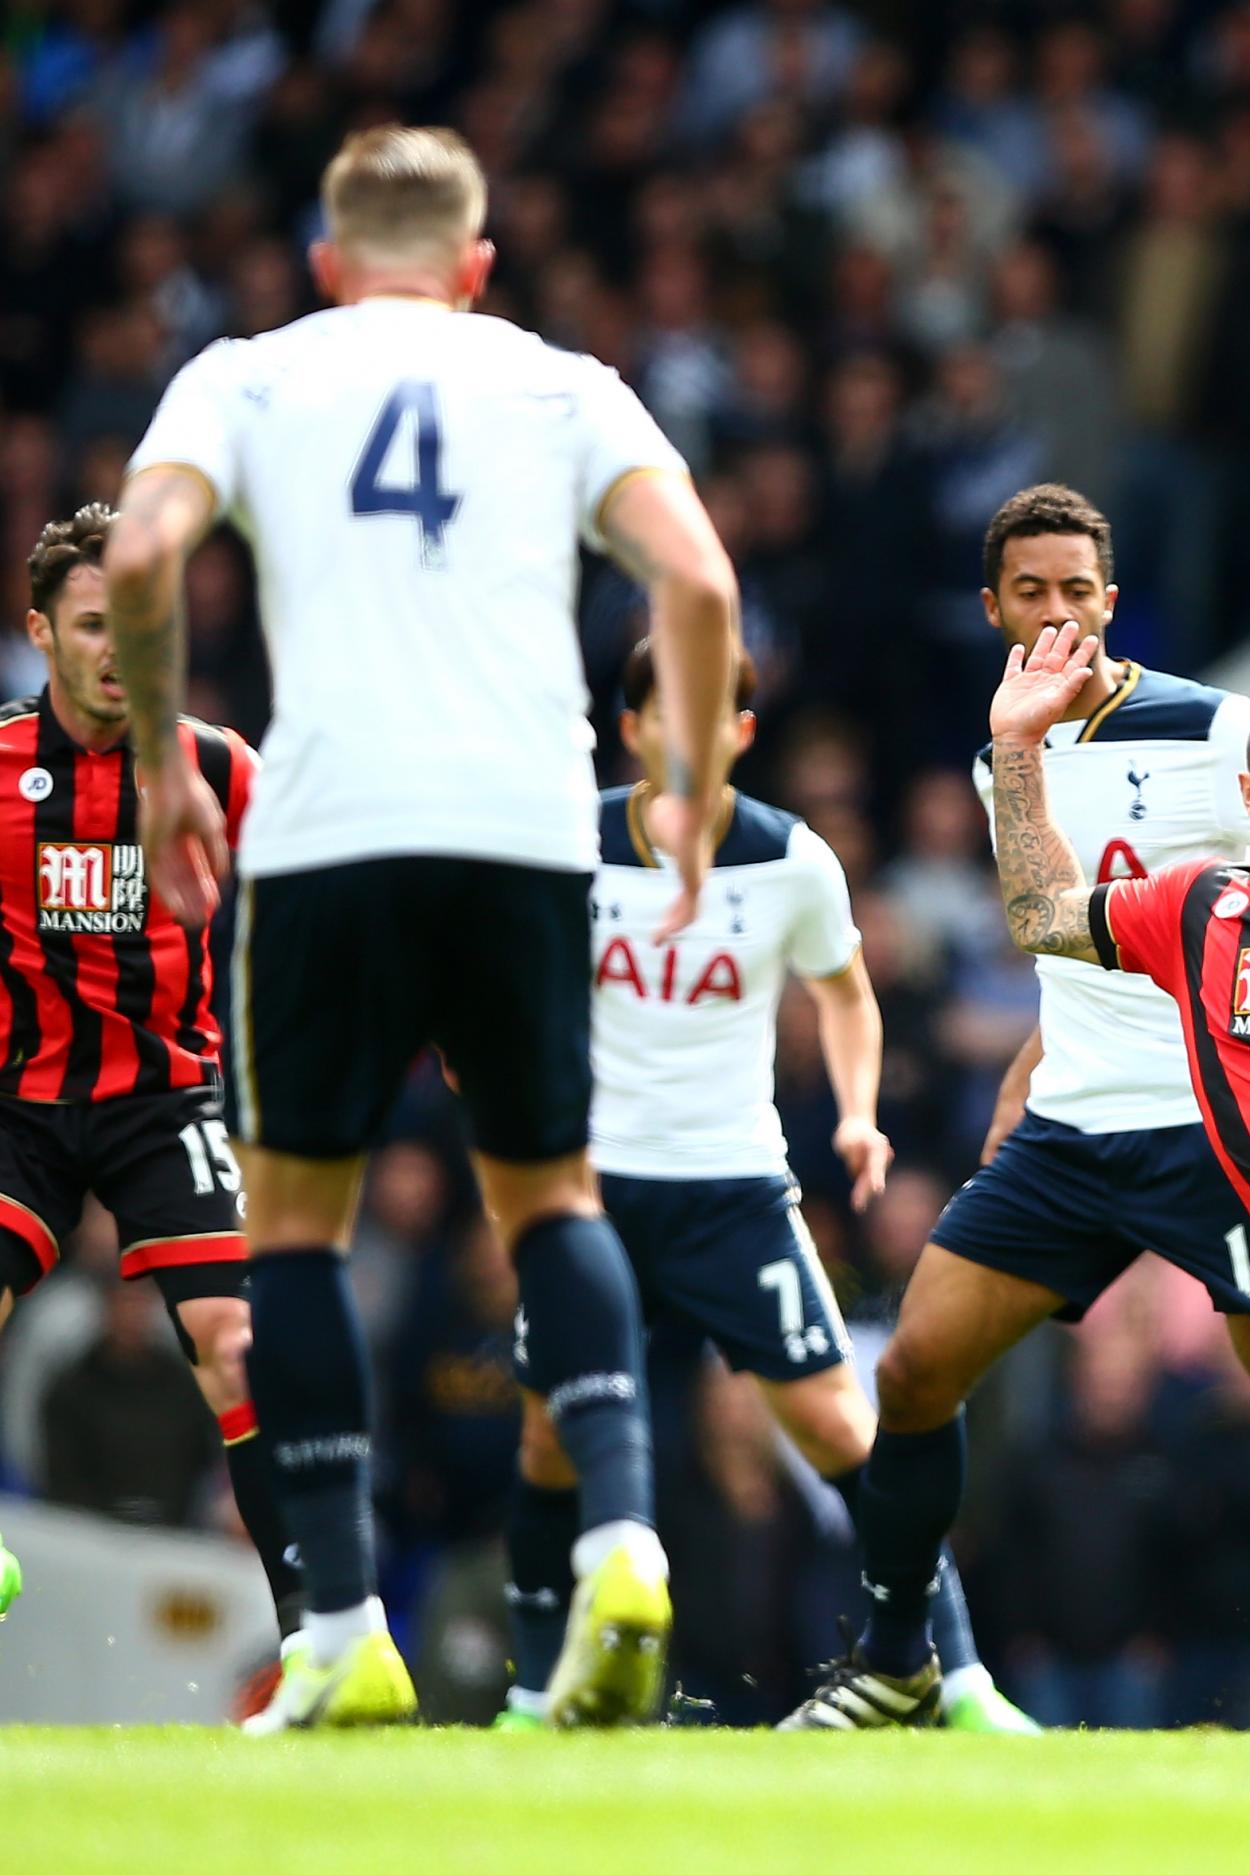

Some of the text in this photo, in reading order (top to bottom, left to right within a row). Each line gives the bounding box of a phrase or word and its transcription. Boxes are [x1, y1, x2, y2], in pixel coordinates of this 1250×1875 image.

[347, 381, 463, 569] 4
[40, 911, 144, 933] MANSION
[596, 936, 741, 1005] AIA
[177, 1120, 241, 1195] 15
[757, 1258, 804, 1335] 7
